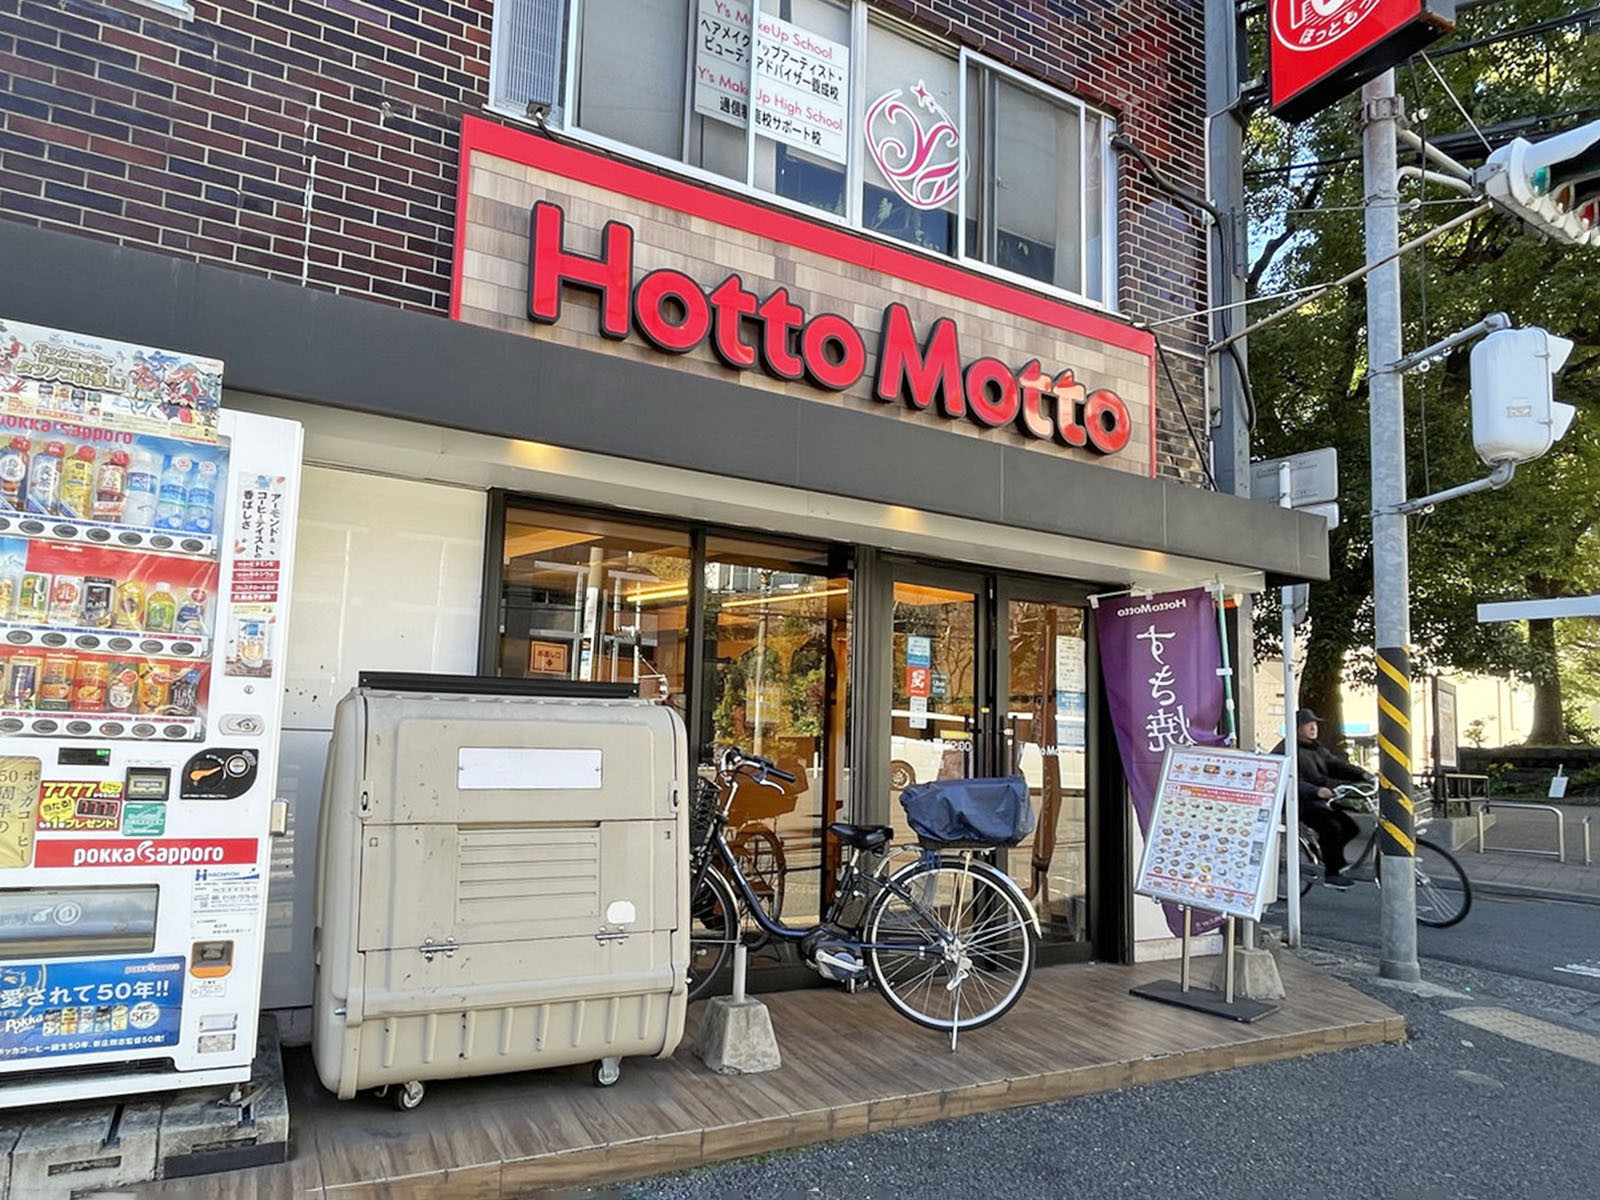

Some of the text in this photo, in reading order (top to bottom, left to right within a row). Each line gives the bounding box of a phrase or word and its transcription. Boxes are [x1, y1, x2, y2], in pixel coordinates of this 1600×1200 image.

[793, 33, 832, 59] School
[774, 94, 801, 116] High
[806, 107, 843, 131] School
[527, 199, 1132, 456] Hotto Motto
[42, 782, 98, 797] 7777
[18, 770, 40, 862] ポッカコーヒー
